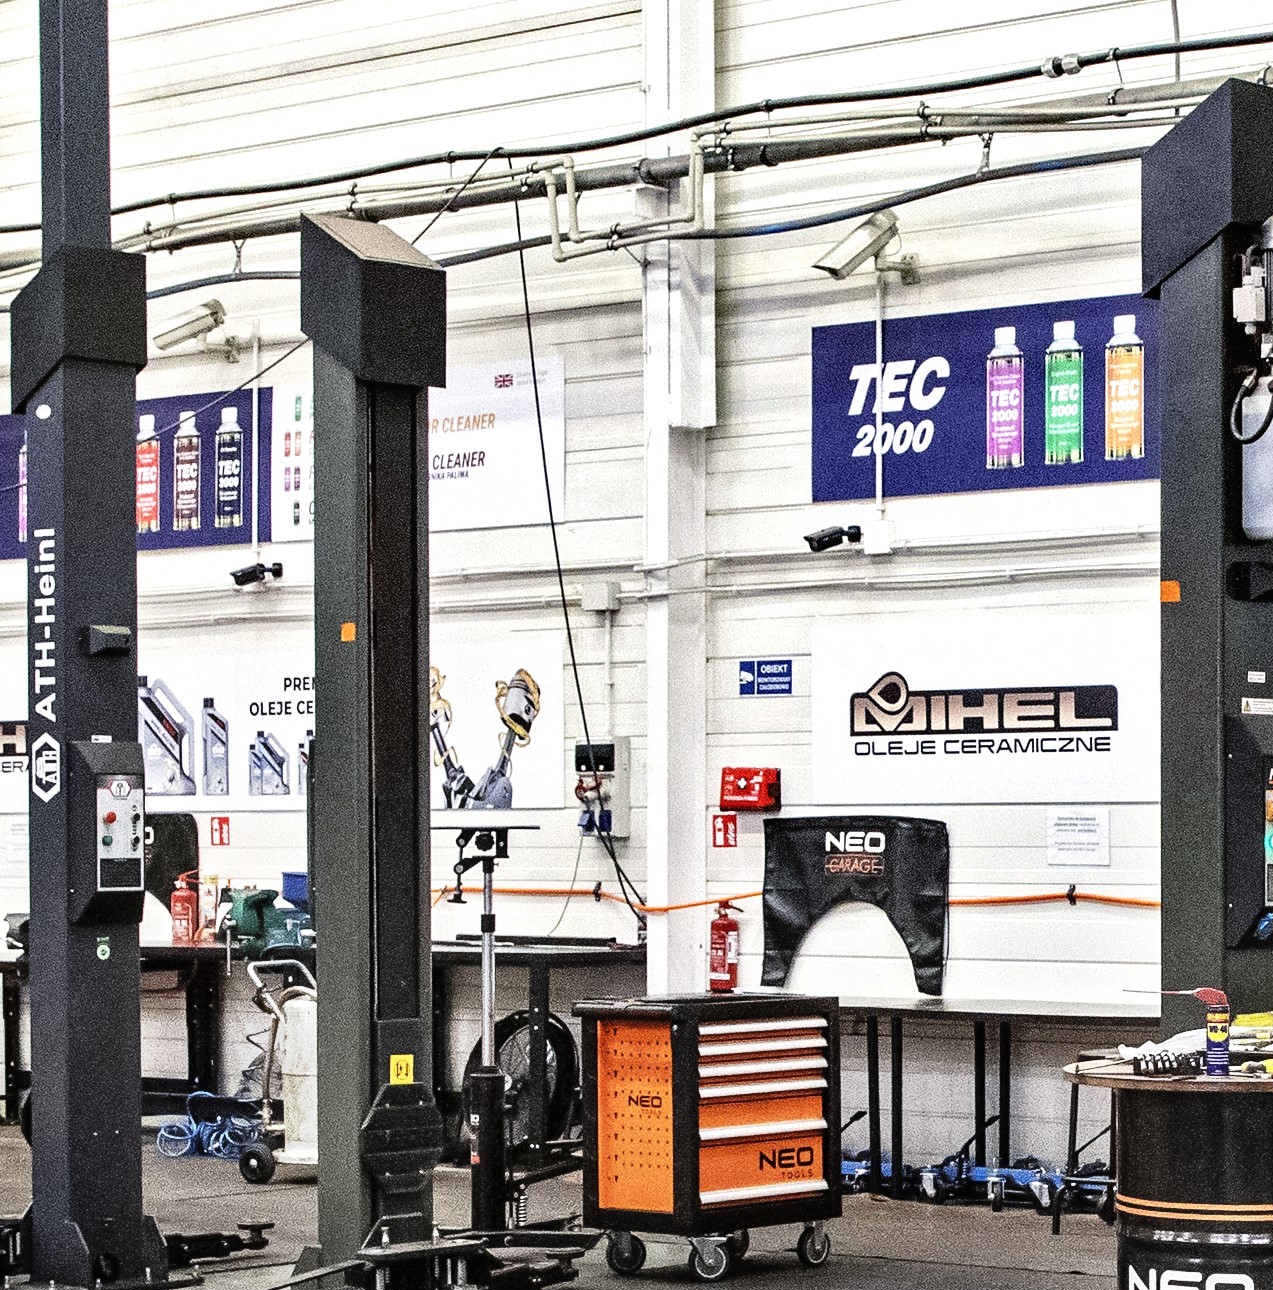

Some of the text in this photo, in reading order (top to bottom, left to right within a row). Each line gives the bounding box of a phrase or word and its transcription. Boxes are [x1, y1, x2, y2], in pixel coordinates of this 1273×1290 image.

[848, 356, 950, 415] TEC
[1050, 383, 1079, 401] TEC
[1110, 378, 1140, 397] TEC
[990, 388, 1020, 407] TEC
[1051, 404, 1078, 417] 2000
[442, 413, 496, 433] CLEANER
[852, 419, 934, 457] 2000
[218, 459, 240, 476] TEC
[432, 451, 486, 470] CLEANER
[137, 466, 157, 482] TEC
[177, 463, 198, 479] TEC
[34, 528, 56, 722] ATH-Heinl
[760, 664, 788, 674] OBIEKT
[249, 701, 292, 716] OLEJE
[853, 672, 1113, 732] MIHEL
[854, 737, 1111, 756] OLEJE CERAMICZNE
[825, 831, 885, 853] NEO
[827, 858, 883, 874] GARAGE
[628, 1095, 662, 1108] NEO
[759, 1146, 814, 1170] NEO
[781, 1169, 814, 1179] TOOLS
